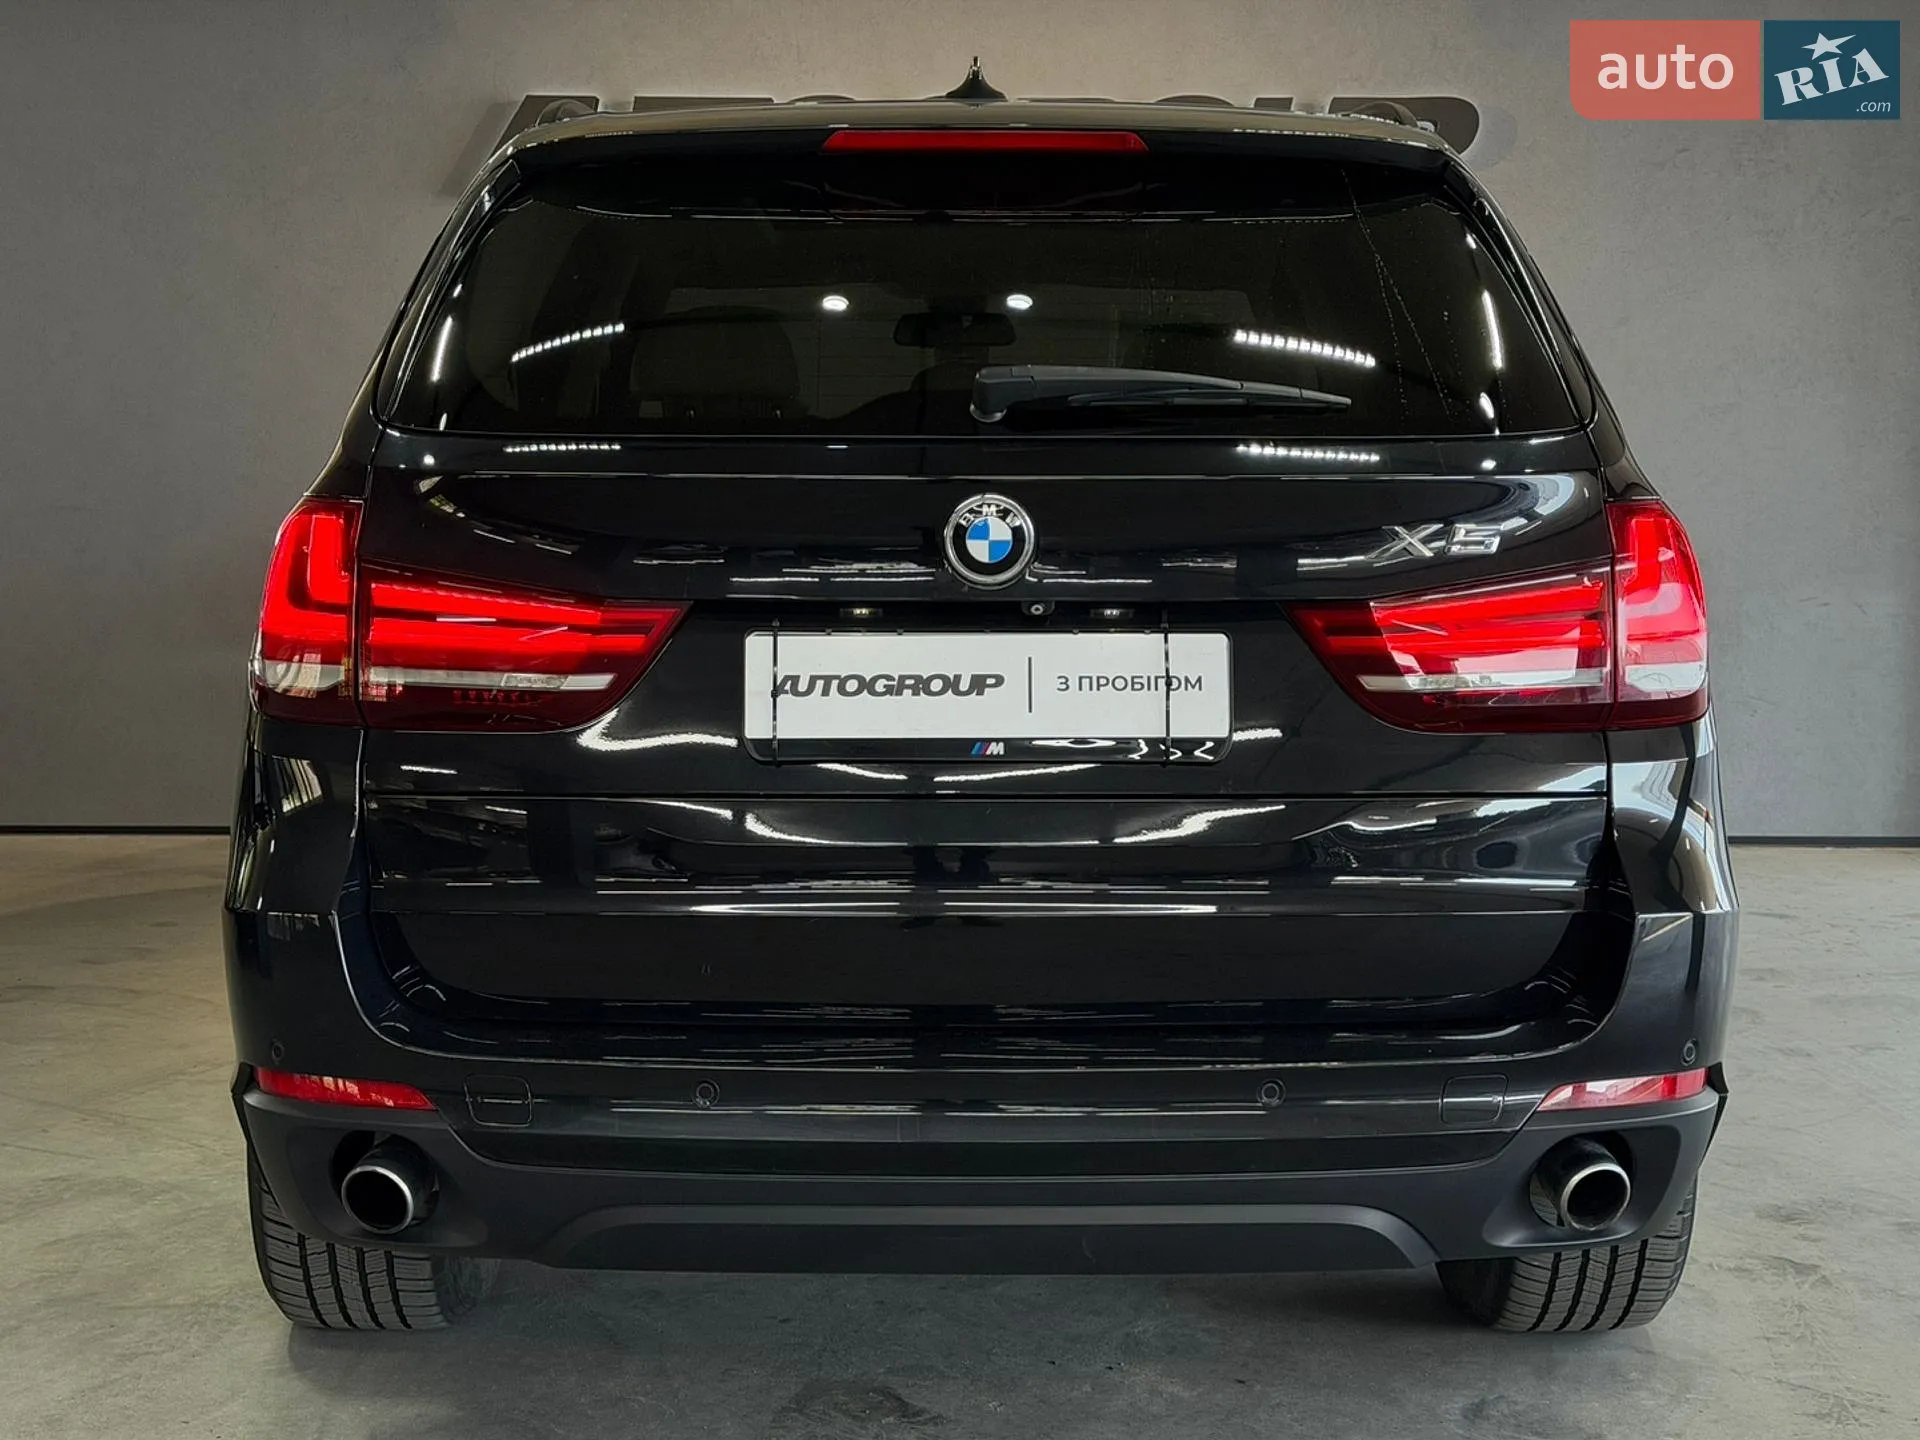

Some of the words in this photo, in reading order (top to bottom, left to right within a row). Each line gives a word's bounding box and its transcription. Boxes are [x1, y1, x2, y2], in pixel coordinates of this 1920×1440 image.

[959, 504, 1021, 528] BMW
[1366, 524, 1500, 557] X5
[774, 674, 1005, 697] AUTOGROUP
[1078, 675, 1203, 692] ПРОБІГОМ
